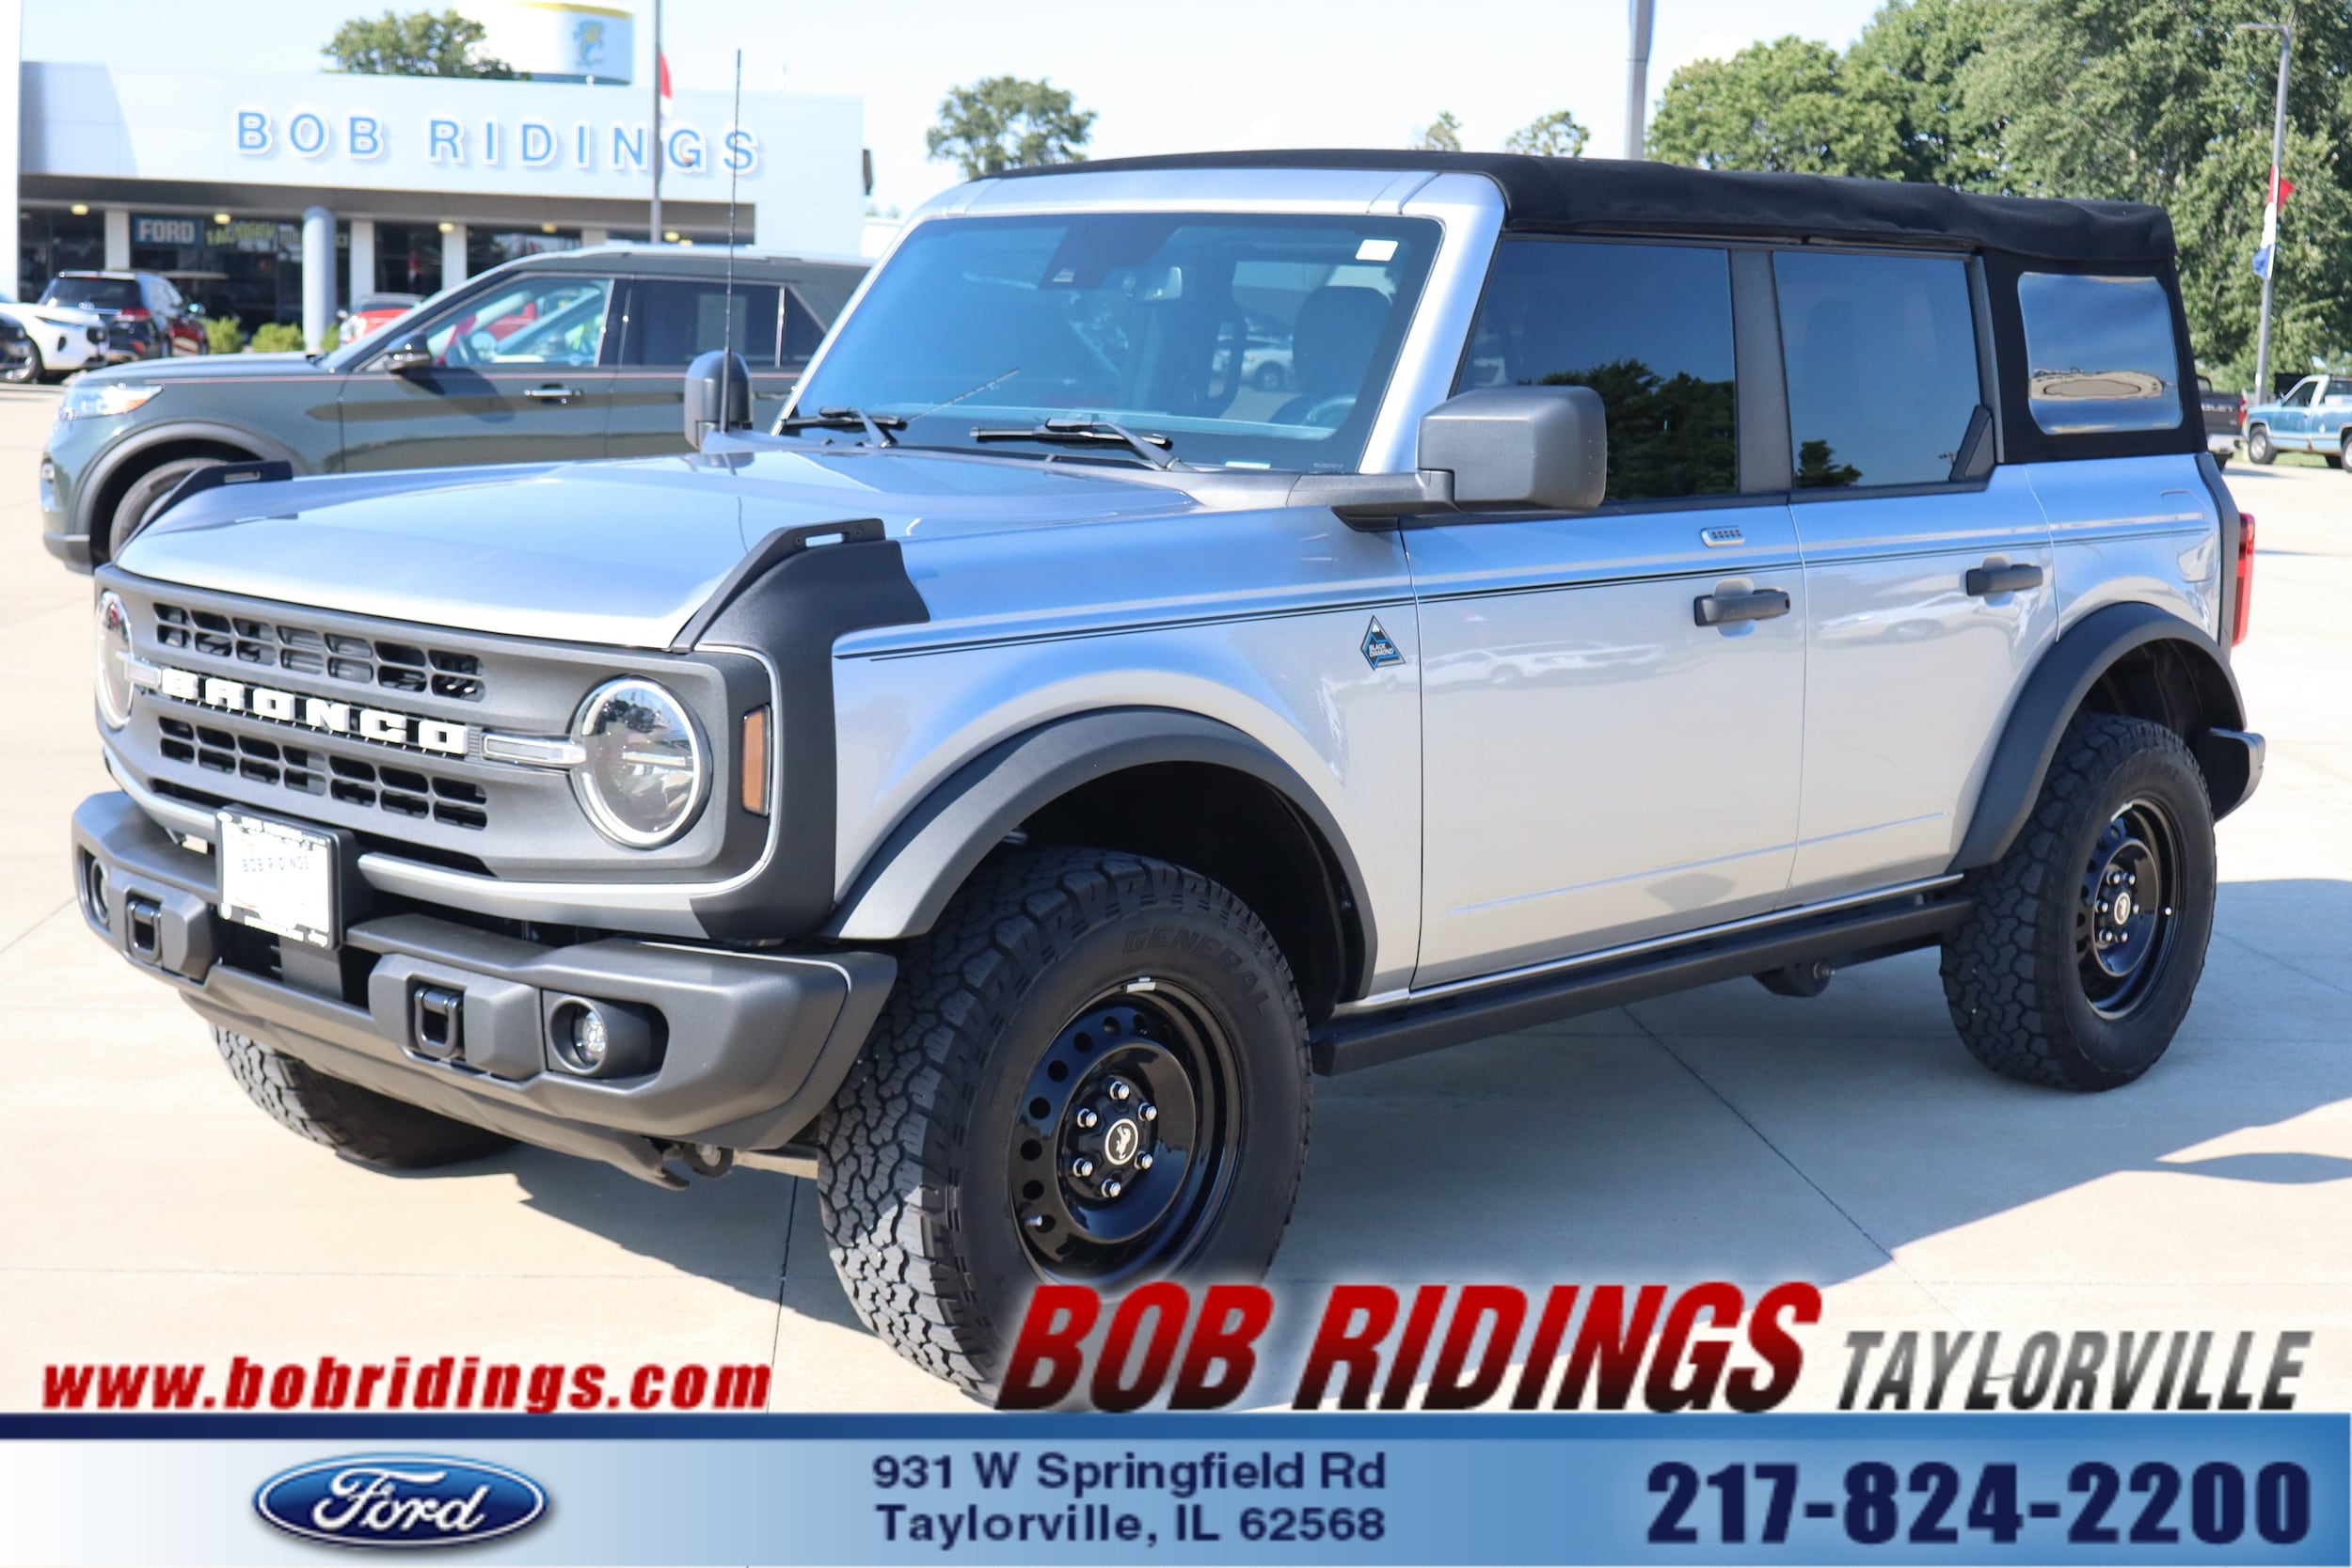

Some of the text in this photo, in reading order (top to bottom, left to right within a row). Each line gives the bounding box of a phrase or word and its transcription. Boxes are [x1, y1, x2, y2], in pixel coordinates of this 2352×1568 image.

[237, 110, 755, 171] BOB RIDINGS
[140, 219, 196, 244] FORD
[162, 668, 469, 753] BRONCO
[243, 855, 310, 873] BOB RDNGS
[1122, 926, 1270, 1016] GENERAL
